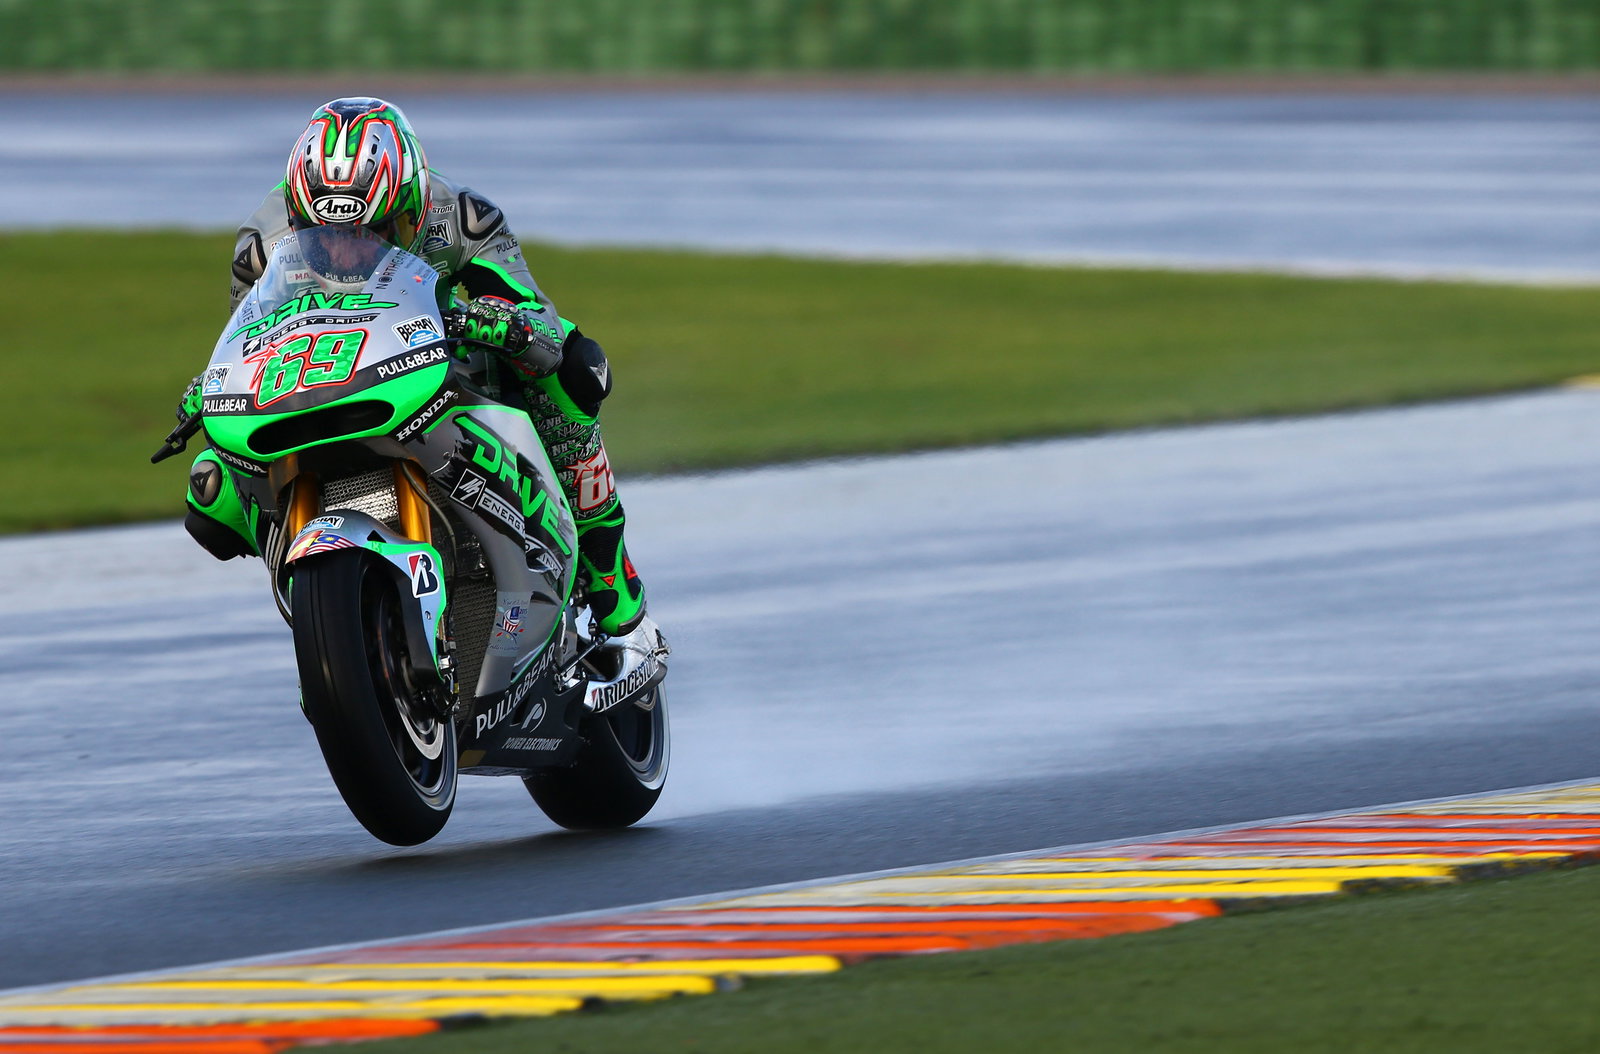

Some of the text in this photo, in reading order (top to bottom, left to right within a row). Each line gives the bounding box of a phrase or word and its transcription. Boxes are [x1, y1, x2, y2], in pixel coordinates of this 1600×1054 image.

[316, 199, 360, 214] Arai
[496, 238, 518, 254] PULL&
[226, 293, 399, 344] DRIVE
[263, 316, 371, 345] ENERGY DRINK
[256, 330, 367, 408] 69
[376, 347, 447, 378] PULL&BEAR
[202, 398, 247, 413] PULL&BEAR
[396, 389, 454, 441] HONDA
[212, 446, 267, 473] HONDA
[476, 644, 556, 739] PULL&BEAR
[501, 737, 563, 751] POWER ELECTRONICS
